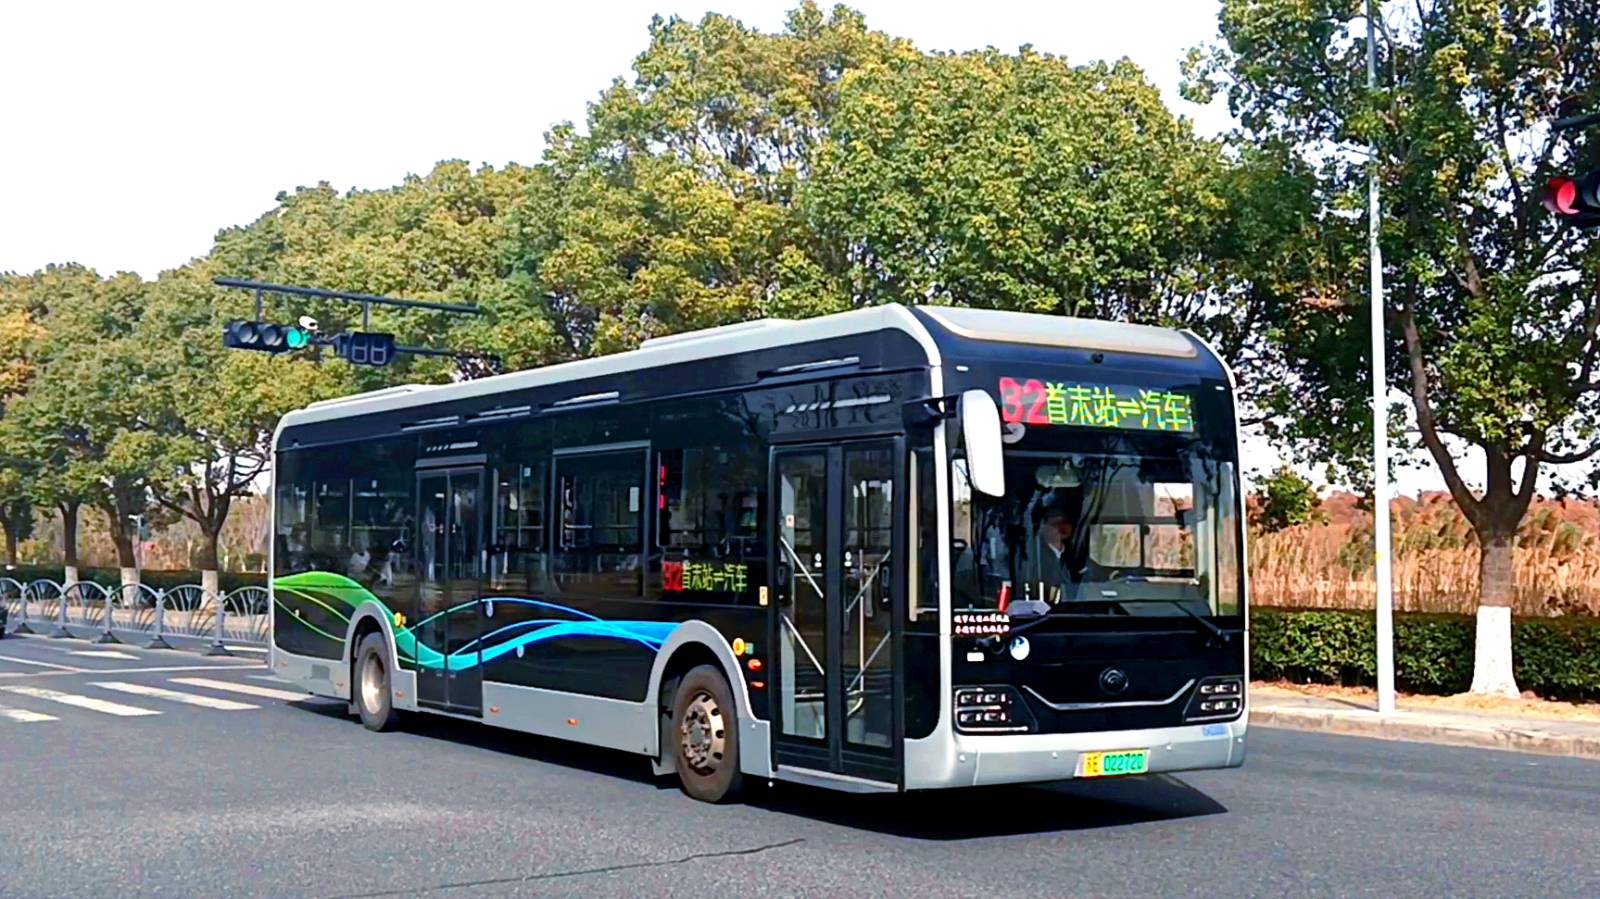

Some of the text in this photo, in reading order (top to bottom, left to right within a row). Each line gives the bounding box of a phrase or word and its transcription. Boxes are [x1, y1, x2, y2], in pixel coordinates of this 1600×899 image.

[1000, 377, 1049, 425] 32
[1046, 382, 1119, 427] 首末站
